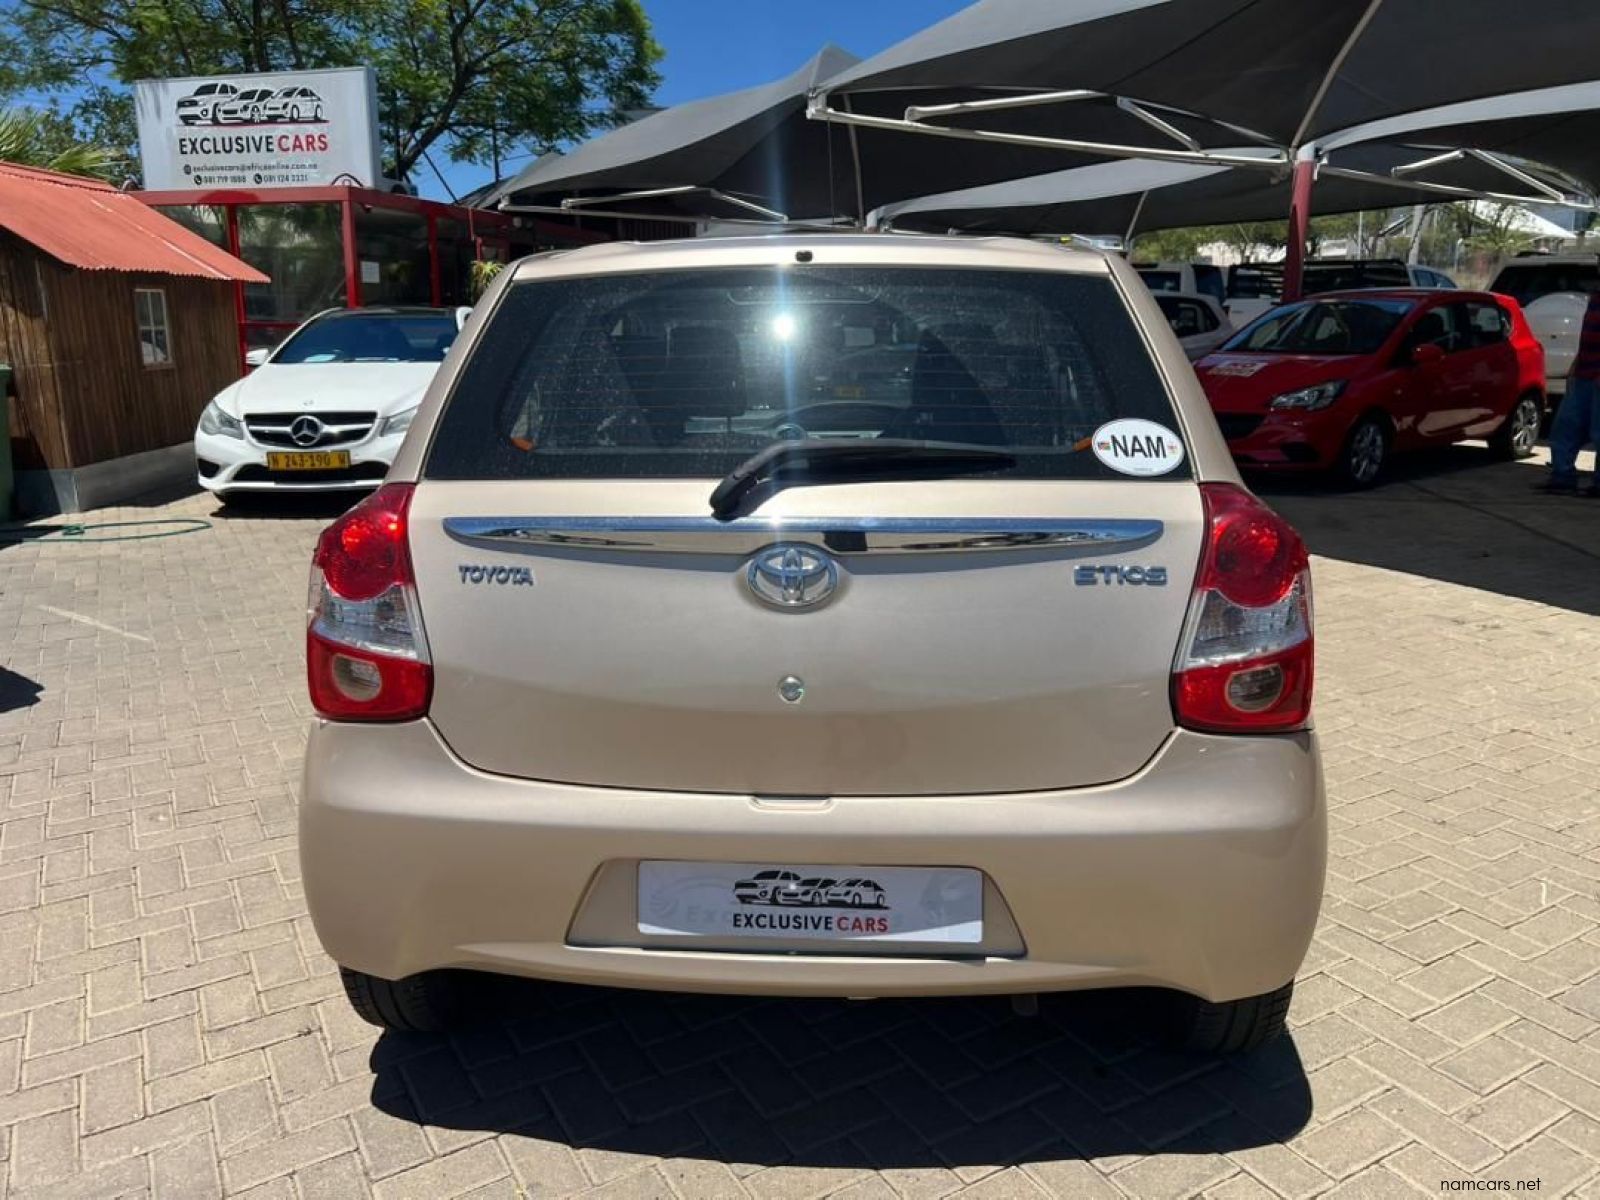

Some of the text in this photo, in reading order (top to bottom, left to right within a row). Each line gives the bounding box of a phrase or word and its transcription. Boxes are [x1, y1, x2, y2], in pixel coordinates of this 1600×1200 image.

[179, 133, 329, 155] EXCLUSIVE CARS
[1110, 434, 1167, 459] NAM
[272, 455, 279, 467] N
[338, 454, 346, 465] W
[458, 564, 534, 586] TOYOTA
[1074, 565, 1167, 586] ETIOS
[732, 913, 834, 931] EXCLUSIVE
[836, 916, 889, 933] CARS
